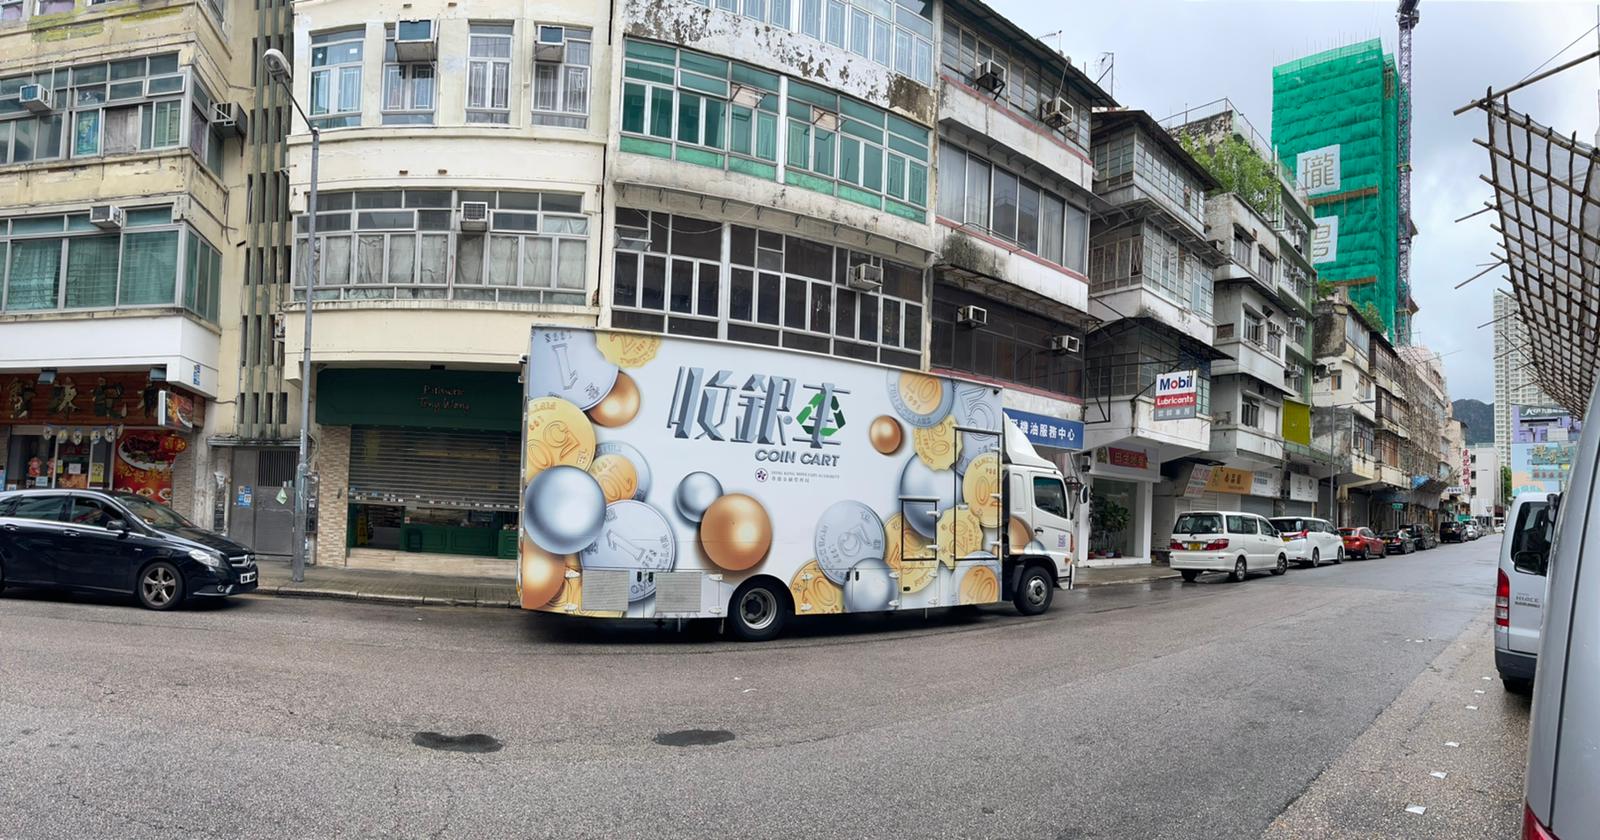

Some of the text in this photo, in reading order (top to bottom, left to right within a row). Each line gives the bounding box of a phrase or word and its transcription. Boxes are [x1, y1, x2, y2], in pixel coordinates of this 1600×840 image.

[1160, 376, 1192, 390] Mobil
[667, 366, 851, 449] 收銀車
[1157, 395, 1194, 406] Lubricants
[1010, 418, 1075, 441] 機油服務中心
[755, 449, 840, 467] COIN CART
